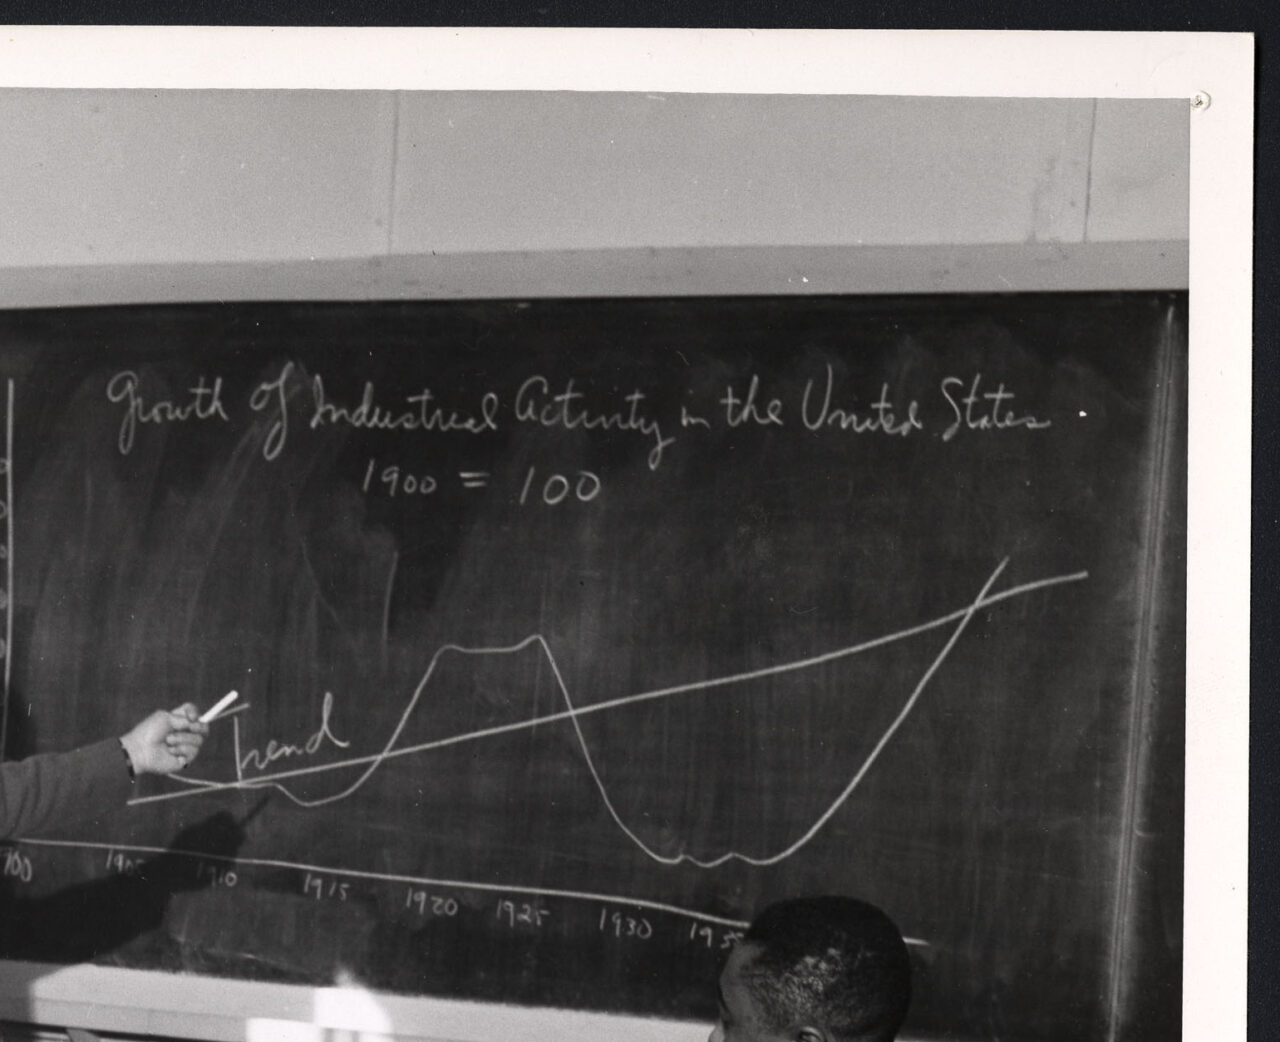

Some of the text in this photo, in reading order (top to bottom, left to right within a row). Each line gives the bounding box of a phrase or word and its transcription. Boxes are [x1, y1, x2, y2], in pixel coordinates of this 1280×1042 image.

[107, 361, 1053, 470] Growth of Industrial Activity in the United States
[362, 459, 438, 498] 1900
[519, 466, 602, 505] 100
[215, 690, 351, 786] Trend
[303, 872, 351, 902] 1915
[405, 886, 460, 917] 1920
[495, 897, 552, 929] 1925
[599, 906, 655, 941] 1930
